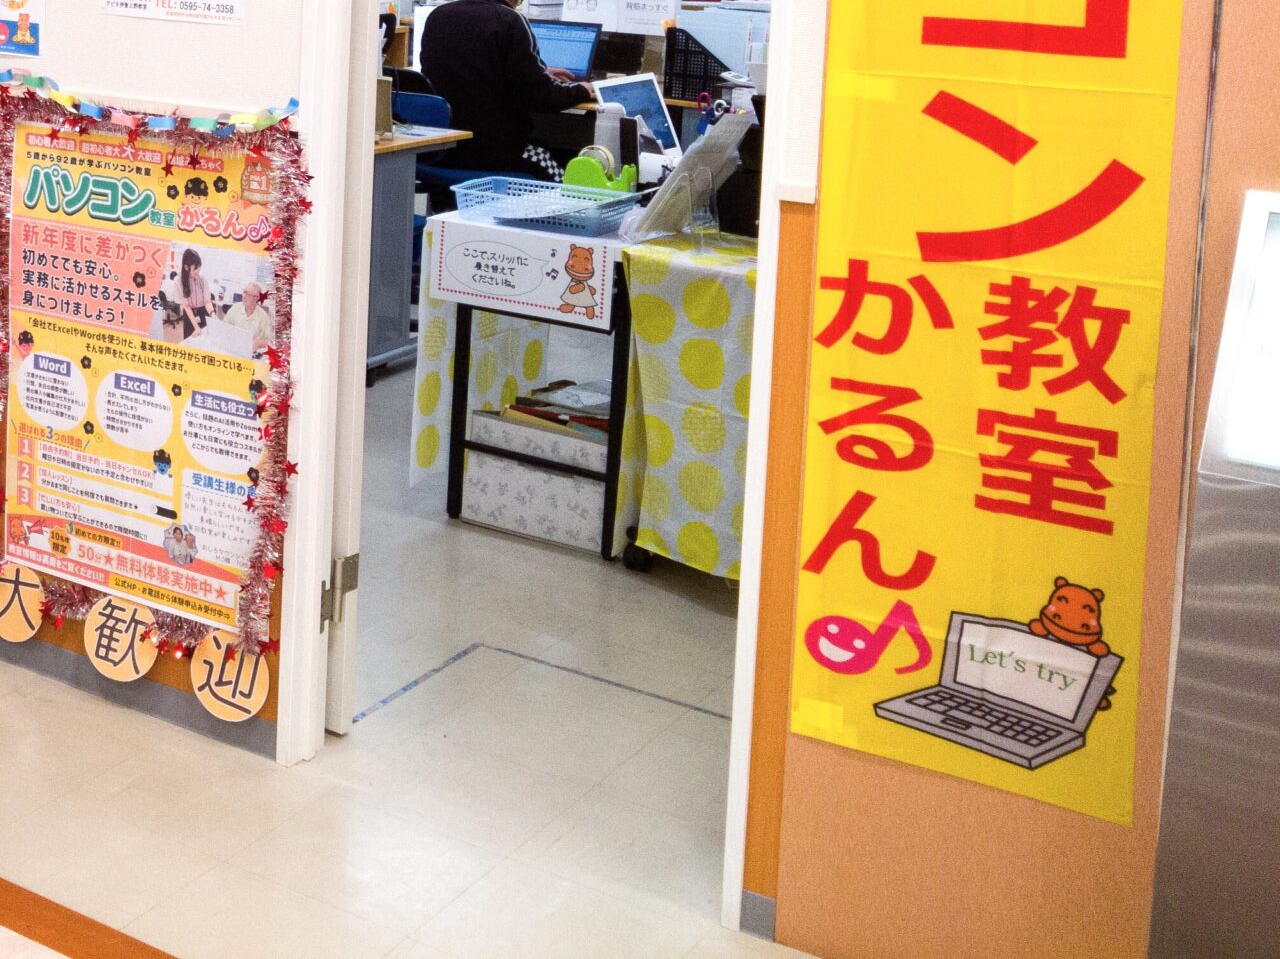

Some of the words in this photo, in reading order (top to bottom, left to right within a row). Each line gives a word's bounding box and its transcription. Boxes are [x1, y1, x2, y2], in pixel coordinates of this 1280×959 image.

[179, 1, 235, 14] 0595-74-3358
[23, 164, 156, 225] パソコン
[148, 209, 177, 228] 教室
[22, 269, 160, 310] 実務に活かせるスキルを
[38, 357, 68, 374] Word
[120, 376, 152, 394] Excel
[194, 394, 254, 417] 生活にも役立つ
[974, 275, 1133, 536] 教室
[801, 258, 955, 591] かるん
[22, 439, 30, 454] 1
[22, 464, 30, 478] 2
[20, 487, 29, 503] 3
[52, 542, 67, 554] 限定
[1036, 662, 1079, 692] try
